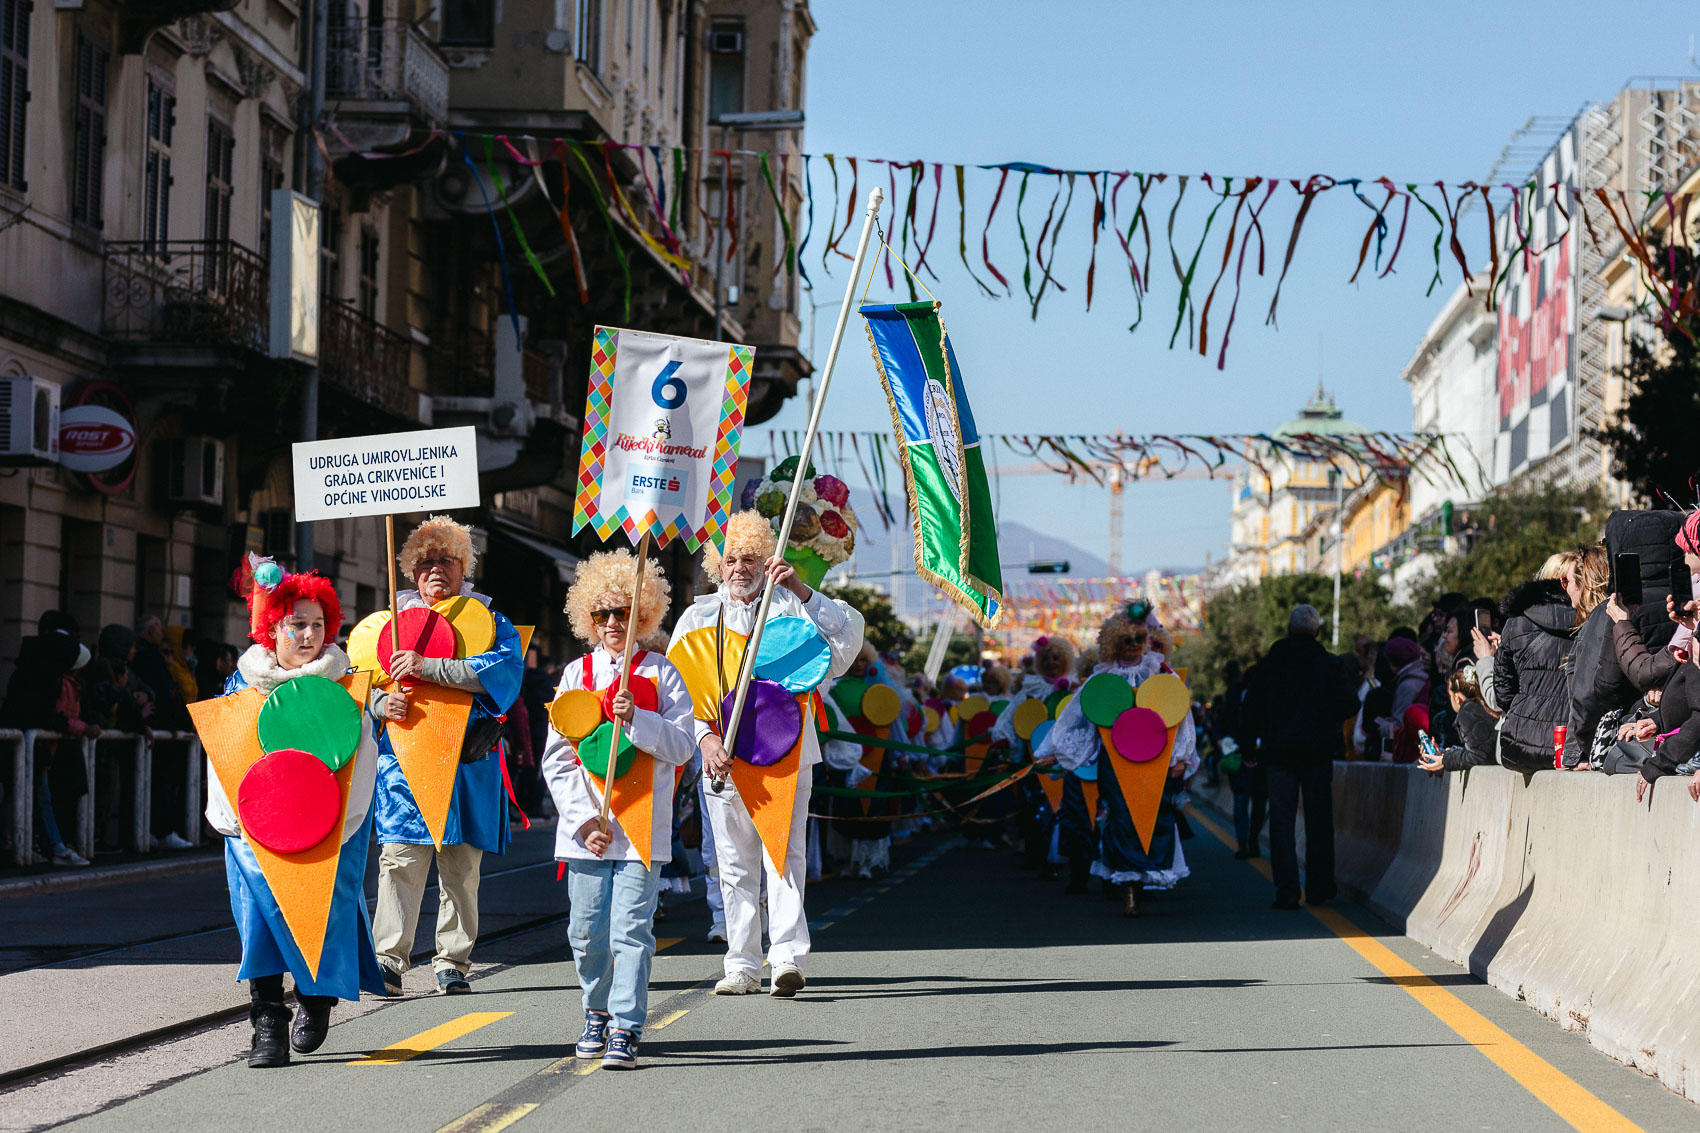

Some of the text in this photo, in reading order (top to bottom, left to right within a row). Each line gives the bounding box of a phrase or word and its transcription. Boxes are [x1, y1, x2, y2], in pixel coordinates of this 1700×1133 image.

[652, 360, 688, 410] 6
[309, 445, 458, 470] UDRUGA UMIROVLJENIKA
[615, 433, 708, 459] Riječki Karneval
[324, 464, 445, 488] GRADA CRIKVENICE I
[632, 475, 667, 490] ERSTE
[324, 484, 446, 506] OPĆINE VINODOLSKE
